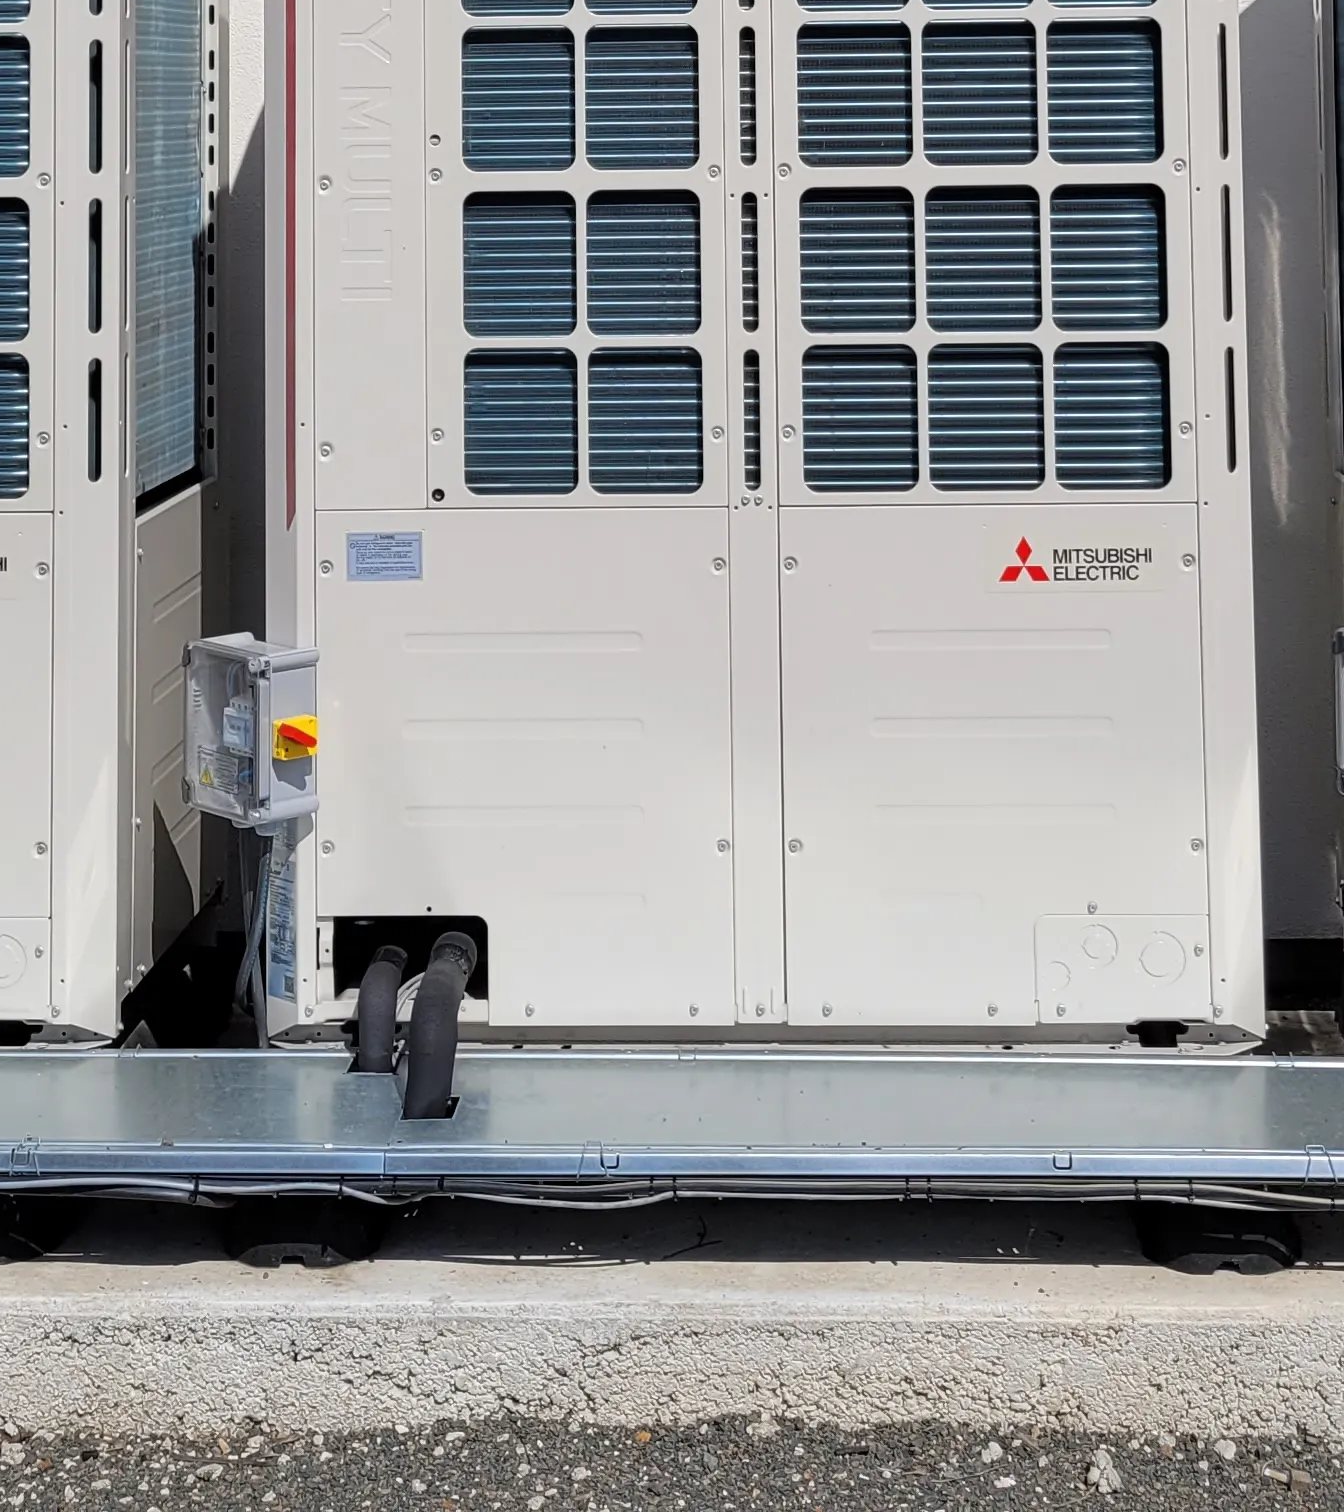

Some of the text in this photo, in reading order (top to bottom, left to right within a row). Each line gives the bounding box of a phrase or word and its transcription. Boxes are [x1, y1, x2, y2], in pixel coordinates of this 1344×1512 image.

[338, 85, 393, 303] MULTI
[1052, 548, 1152, 564] MITSUBISHI
[1053, 565, 1139, 581] ELECTRIC
